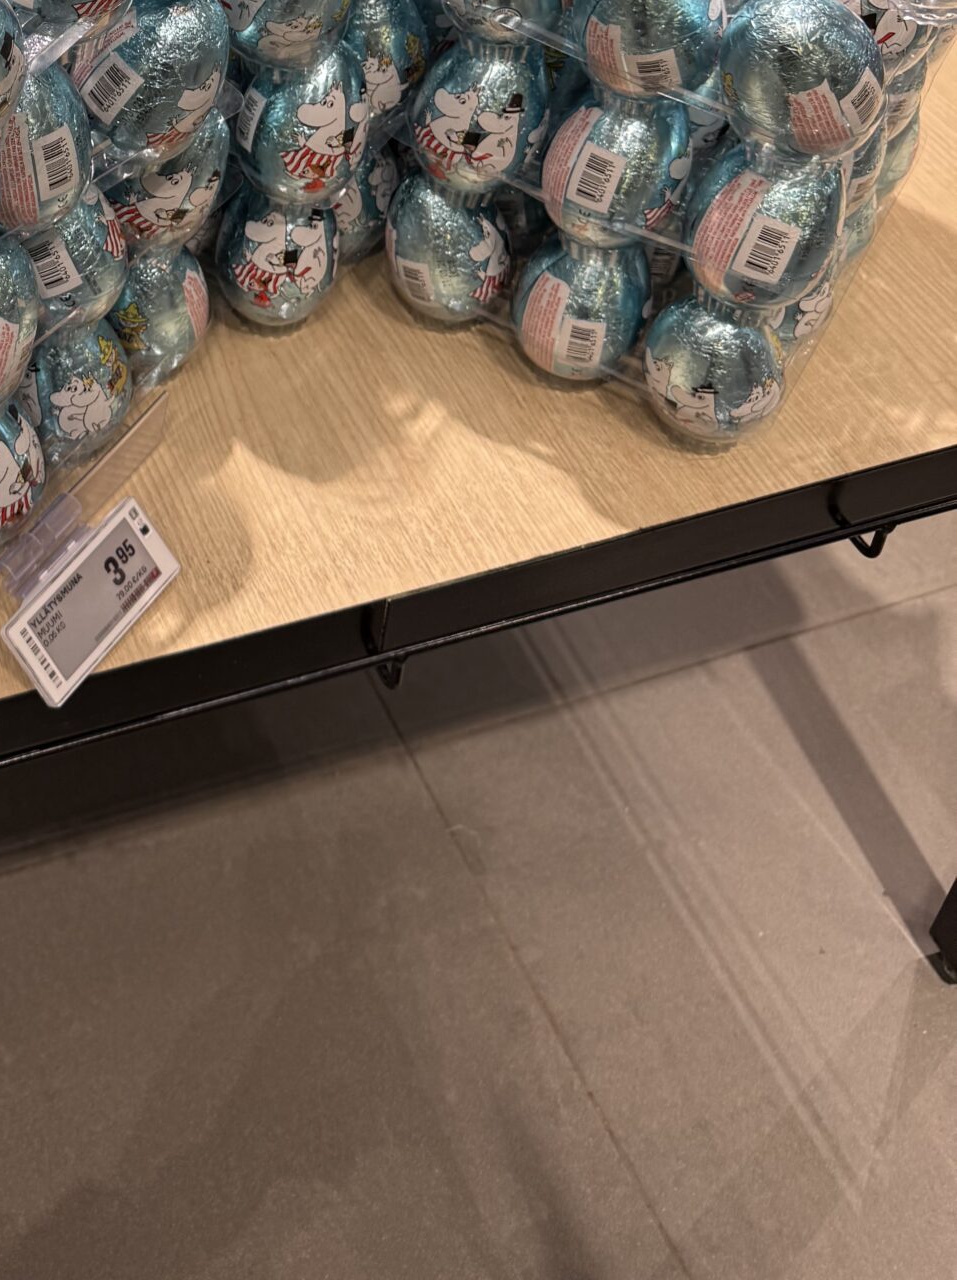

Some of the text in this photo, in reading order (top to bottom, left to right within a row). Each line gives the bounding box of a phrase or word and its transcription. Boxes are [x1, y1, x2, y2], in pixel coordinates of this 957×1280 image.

[104, 538, 136, 586] 3 95
[30, 572, 83, 629] YLLÄTYSMUNA
[37, 611, 64, 639] MUUMI
